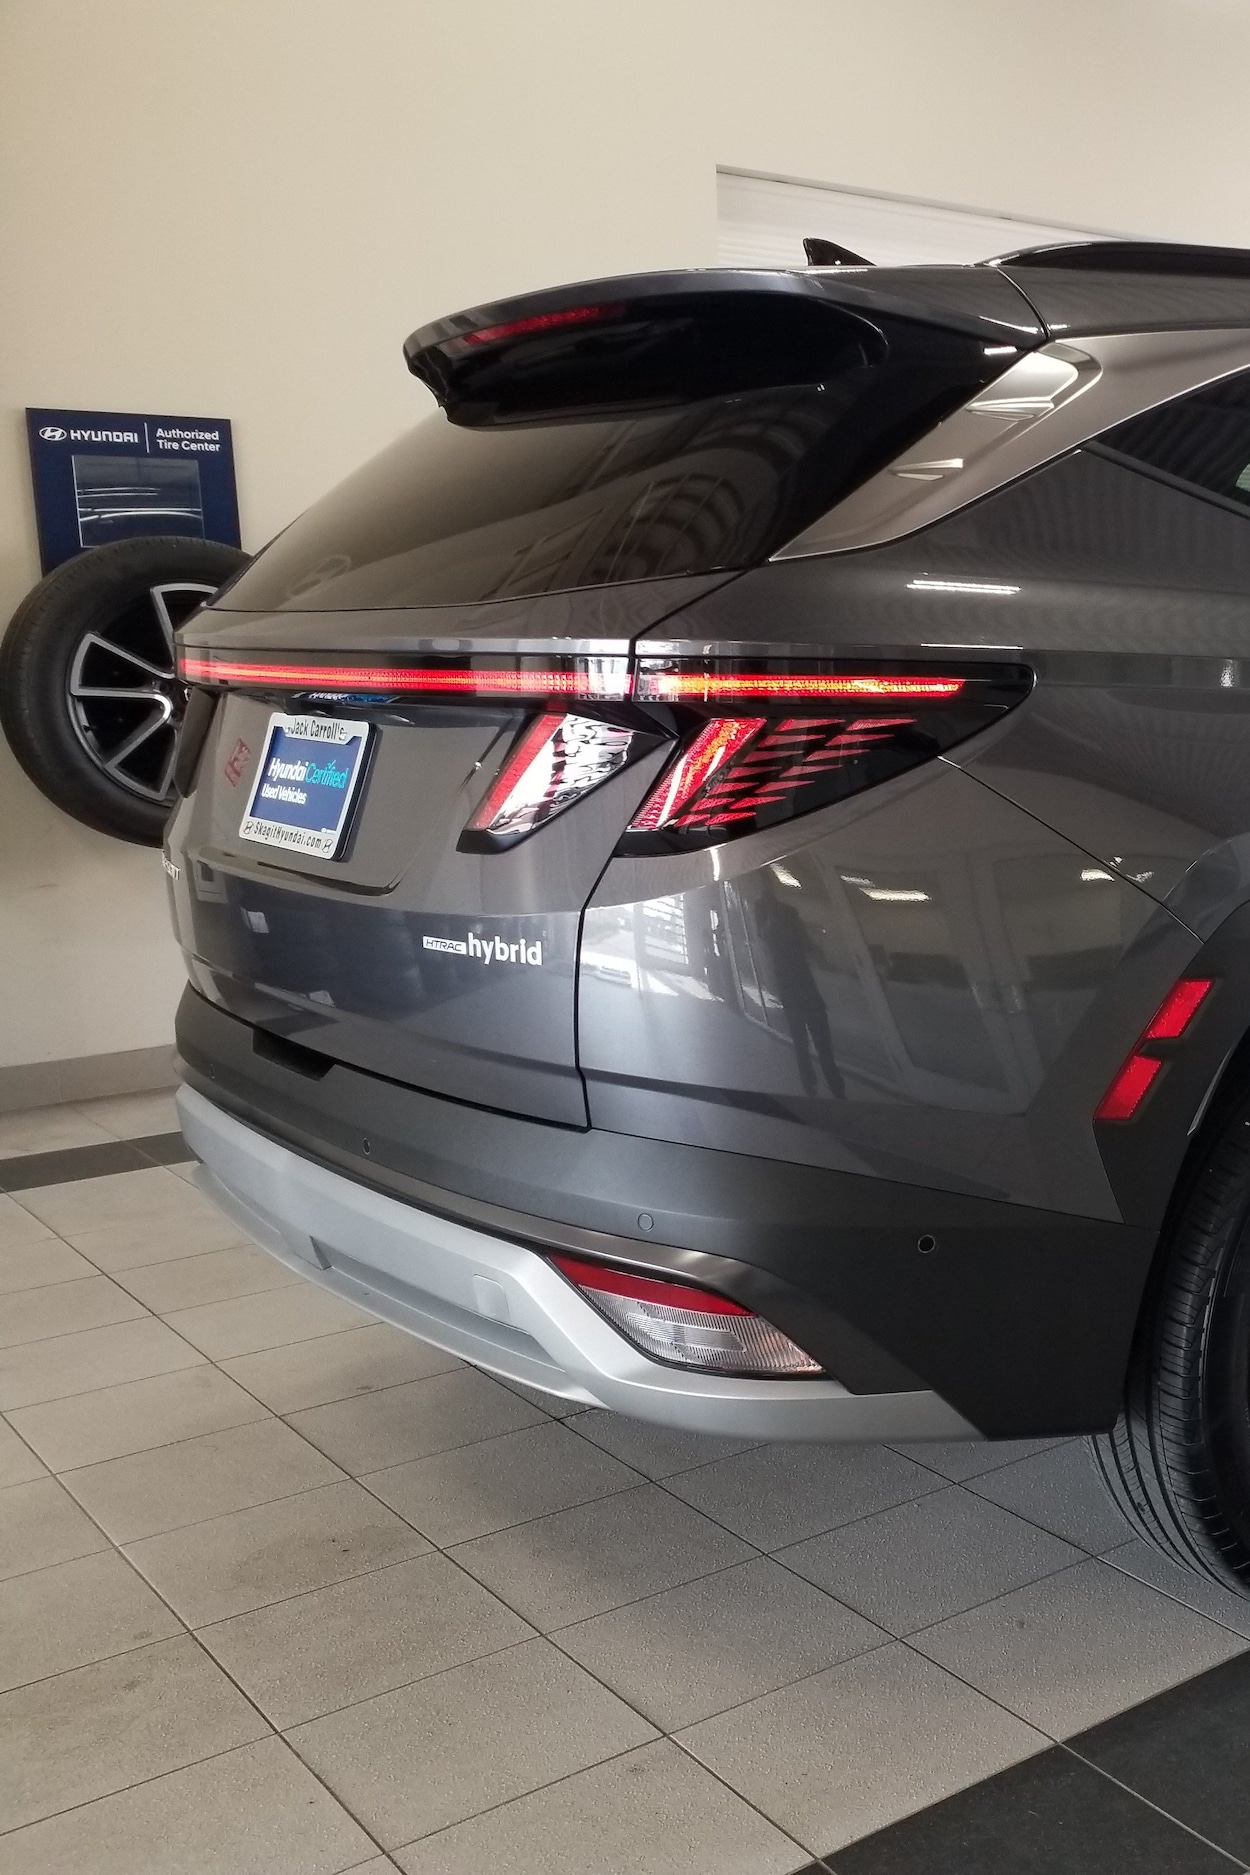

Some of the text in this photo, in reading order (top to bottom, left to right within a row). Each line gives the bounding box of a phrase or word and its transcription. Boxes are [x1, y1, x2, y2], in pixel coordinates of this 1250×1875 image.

[70, 429, 139, 443] HYUNDAI
[156, 427, 220, 441] Authorized
[156, 439, 221, 452] Tire Center
[290, 717, 308, 736] Jack
[261, 783, 308, 805] Used Vehicles
[253, 821, 322, 849] SkagitHyundai.com
[425, 932, 543, 966] HTRAC hybrid
